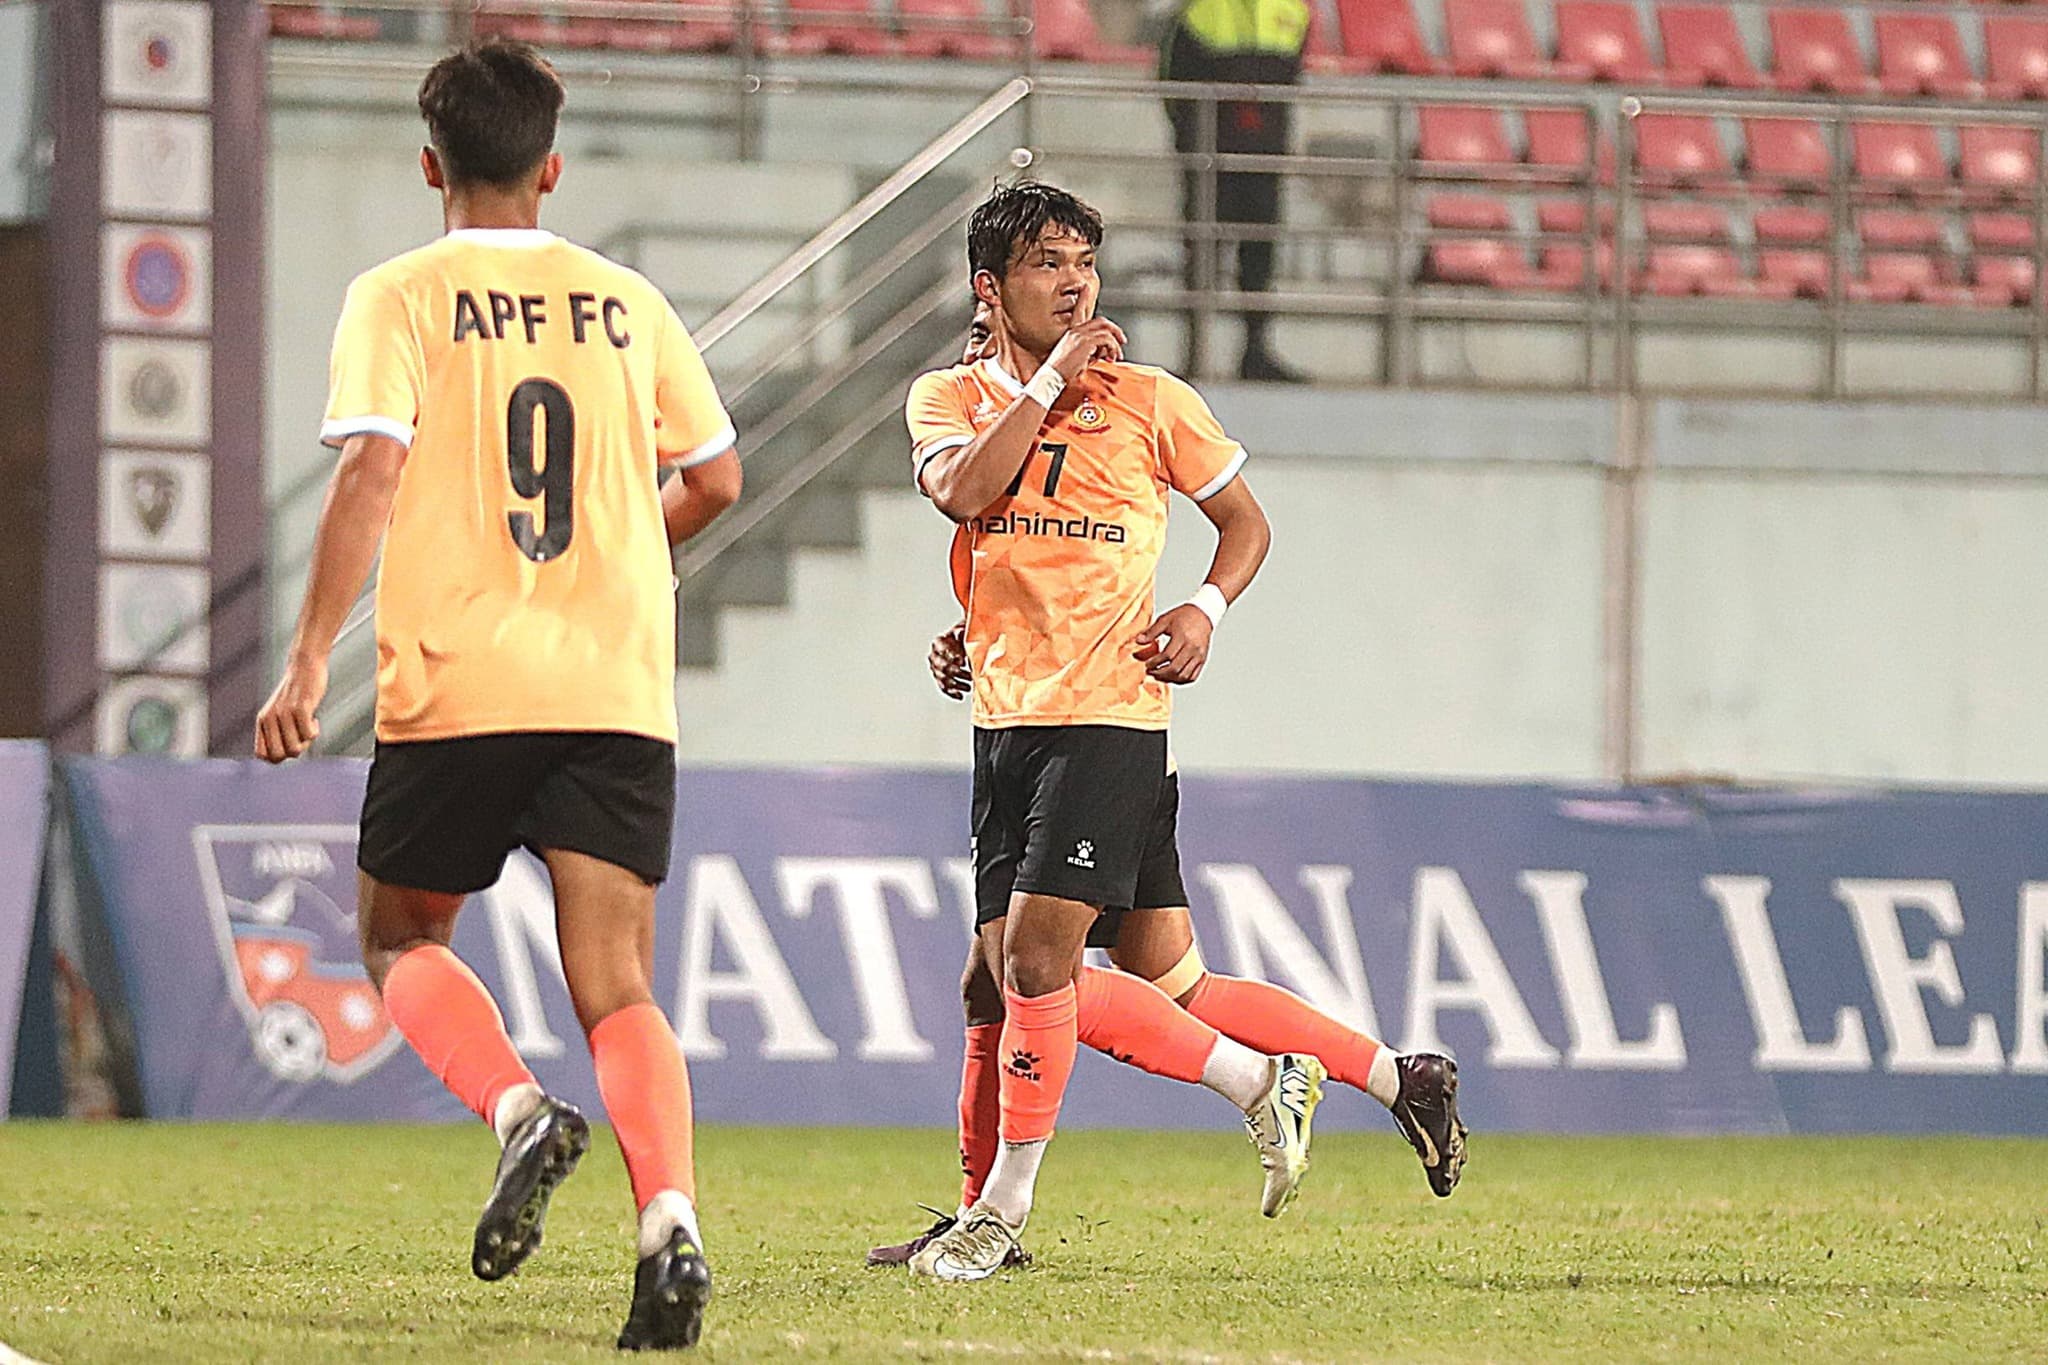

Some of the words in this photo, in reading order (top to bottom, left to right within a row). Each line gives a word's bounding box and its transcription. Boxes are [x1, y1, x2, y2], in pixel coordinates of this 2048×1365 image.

[454, 289, 547, 344] APF
[568, 291, 631, 349] FC
[507, 377, 575, 562] 9
[1067, 856, 1095, 868] KELME
[484, 846, 1688, 1070] ATNAL
[1703, 874, 2048, 1075] LE
